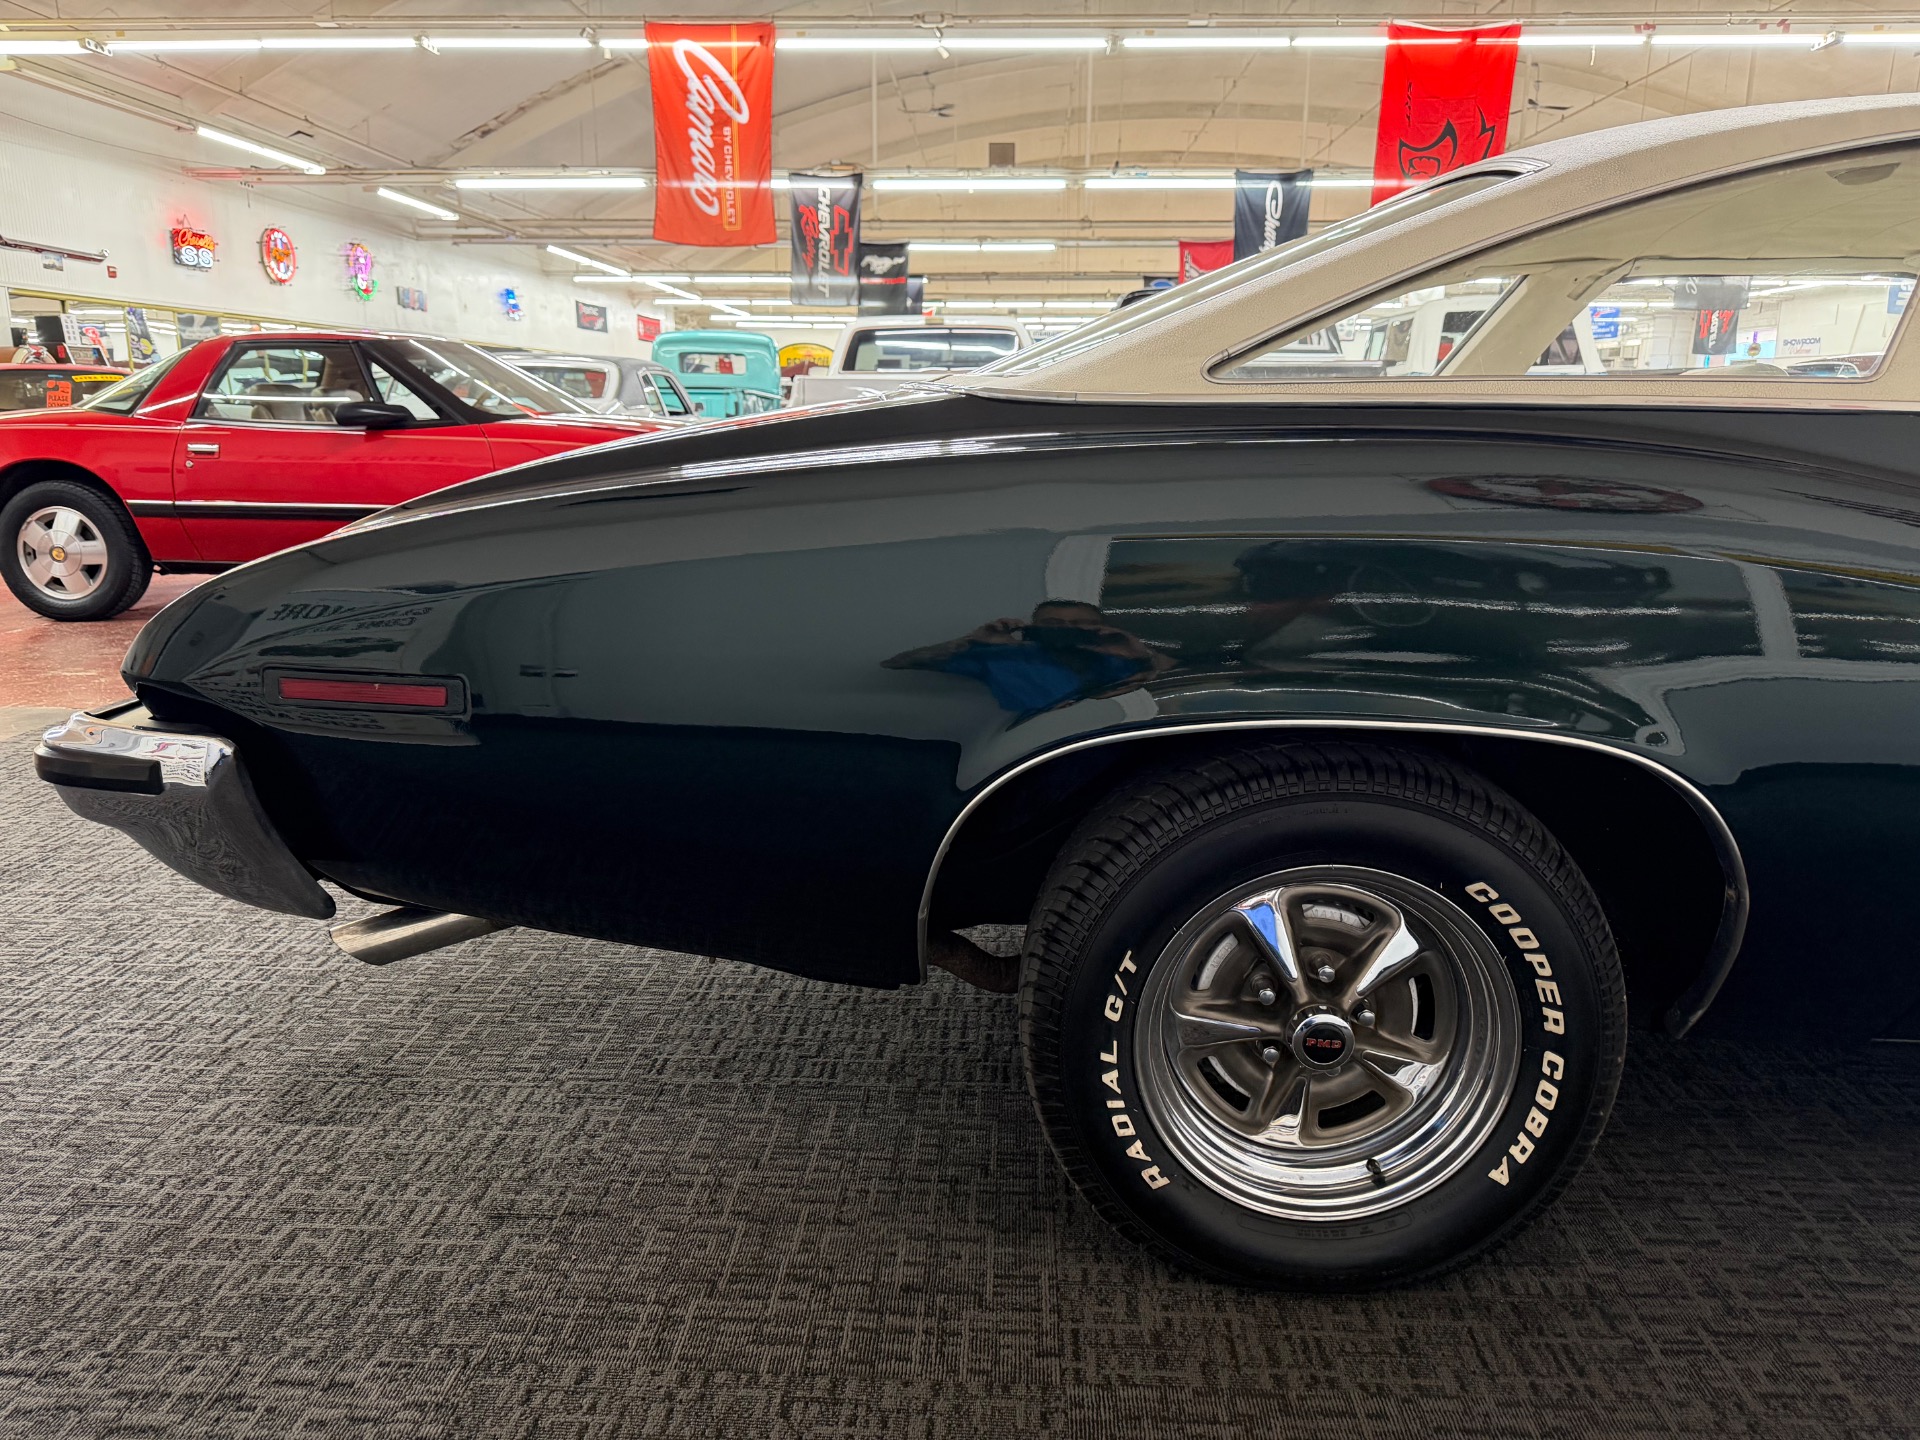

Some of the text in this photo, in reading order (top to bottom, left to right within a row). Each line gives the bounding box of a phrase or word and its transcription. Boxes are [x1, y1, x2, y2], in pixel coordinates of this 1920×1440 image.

[672, 39, 750, 216] Camaro
[722, 126, 731, 143] BY
[180, 245, 214, 267] SS
[817, 186, 831, 298] CHEVROLET
[1783, 337, 1821, 346] SHOWROOM
[1306, 1037, 1343, 1049] PMD
[1465, 881, 1566, 1187] COOPER COBRA
[1100, 950, 1171, 1191] RADIAL G/T
